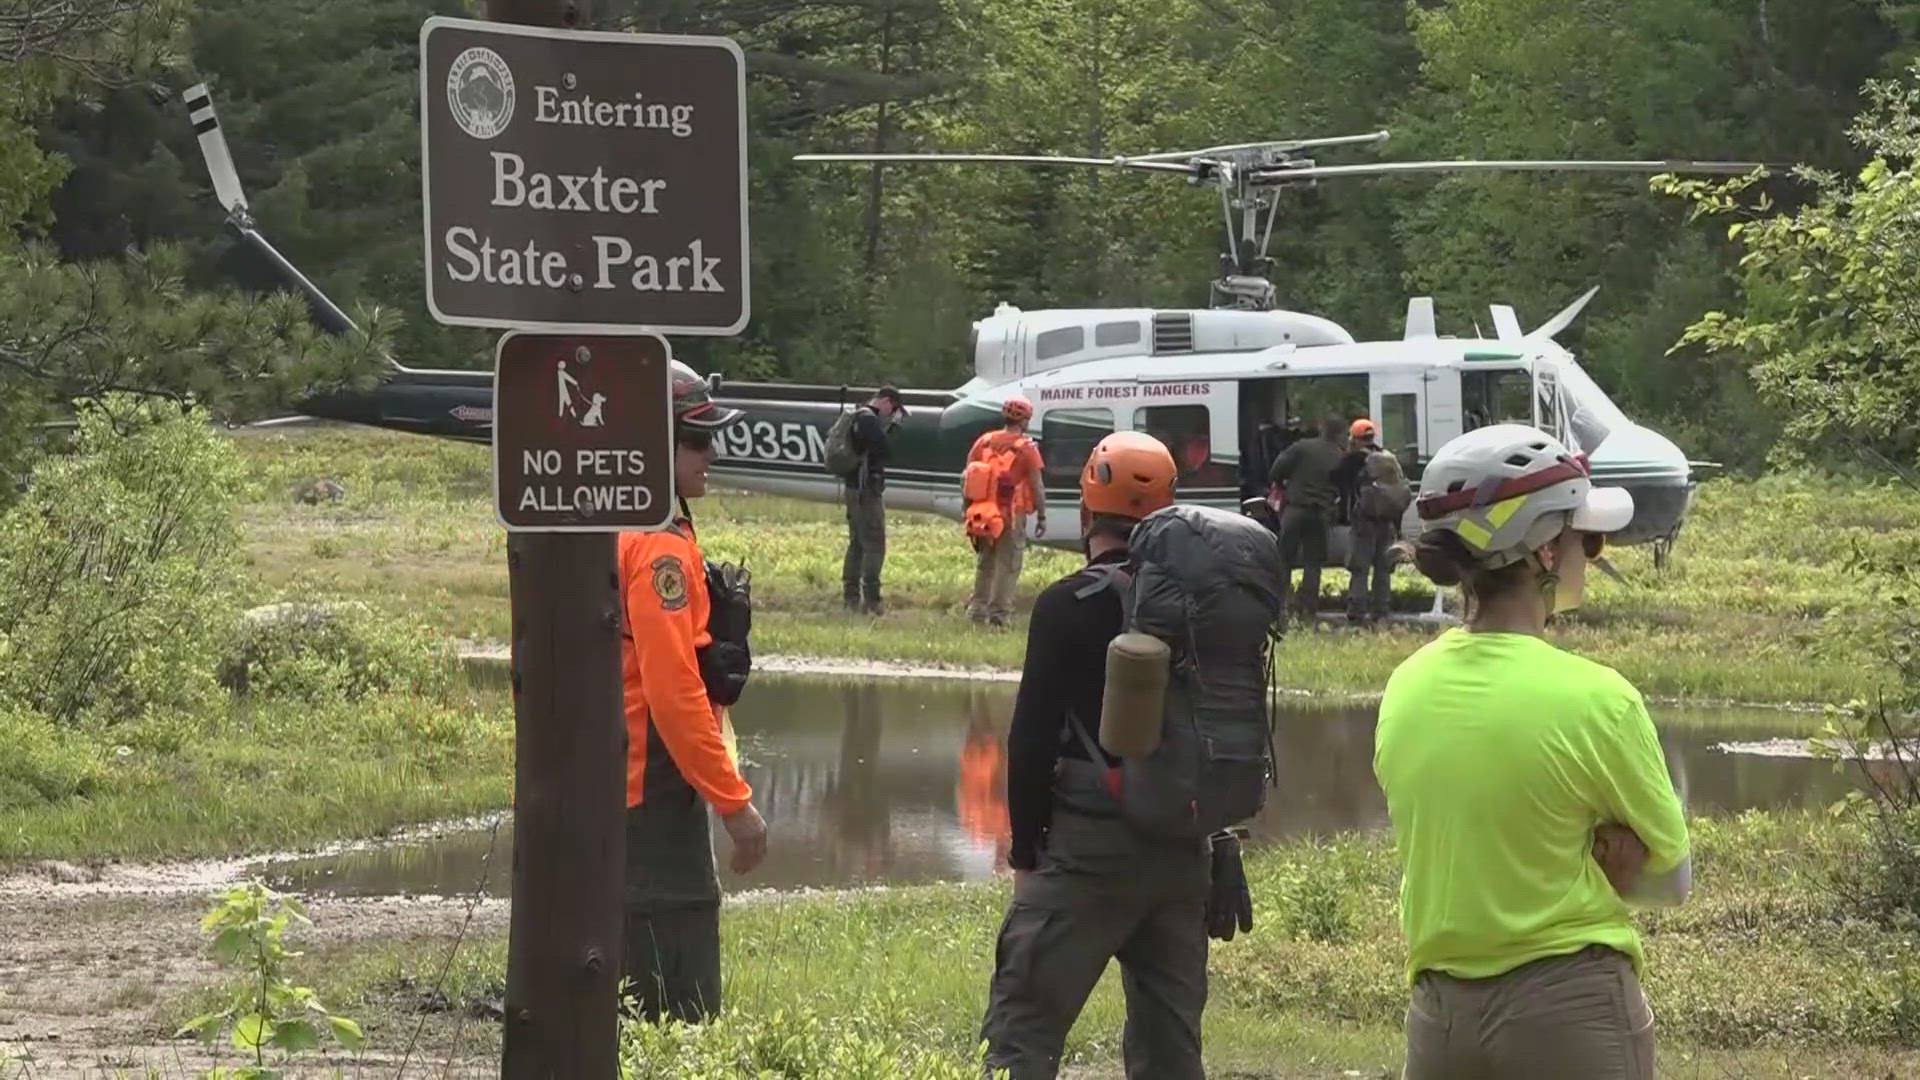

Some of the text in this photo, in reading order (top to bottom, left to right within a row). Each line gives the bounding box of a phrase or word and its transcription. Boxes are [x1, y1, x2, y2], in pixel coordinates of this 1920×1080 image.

[534, 86, 693, 137] Entering
[490, 151, 667, 214] Baxter
[445, 226, 726, 292] State Park
[1040, 383, 1210, 401] MAINE FOREST RANGERS
[523, 450, 645, 475] NO PETS
[519, 486, 652, 511] ALLOWED
